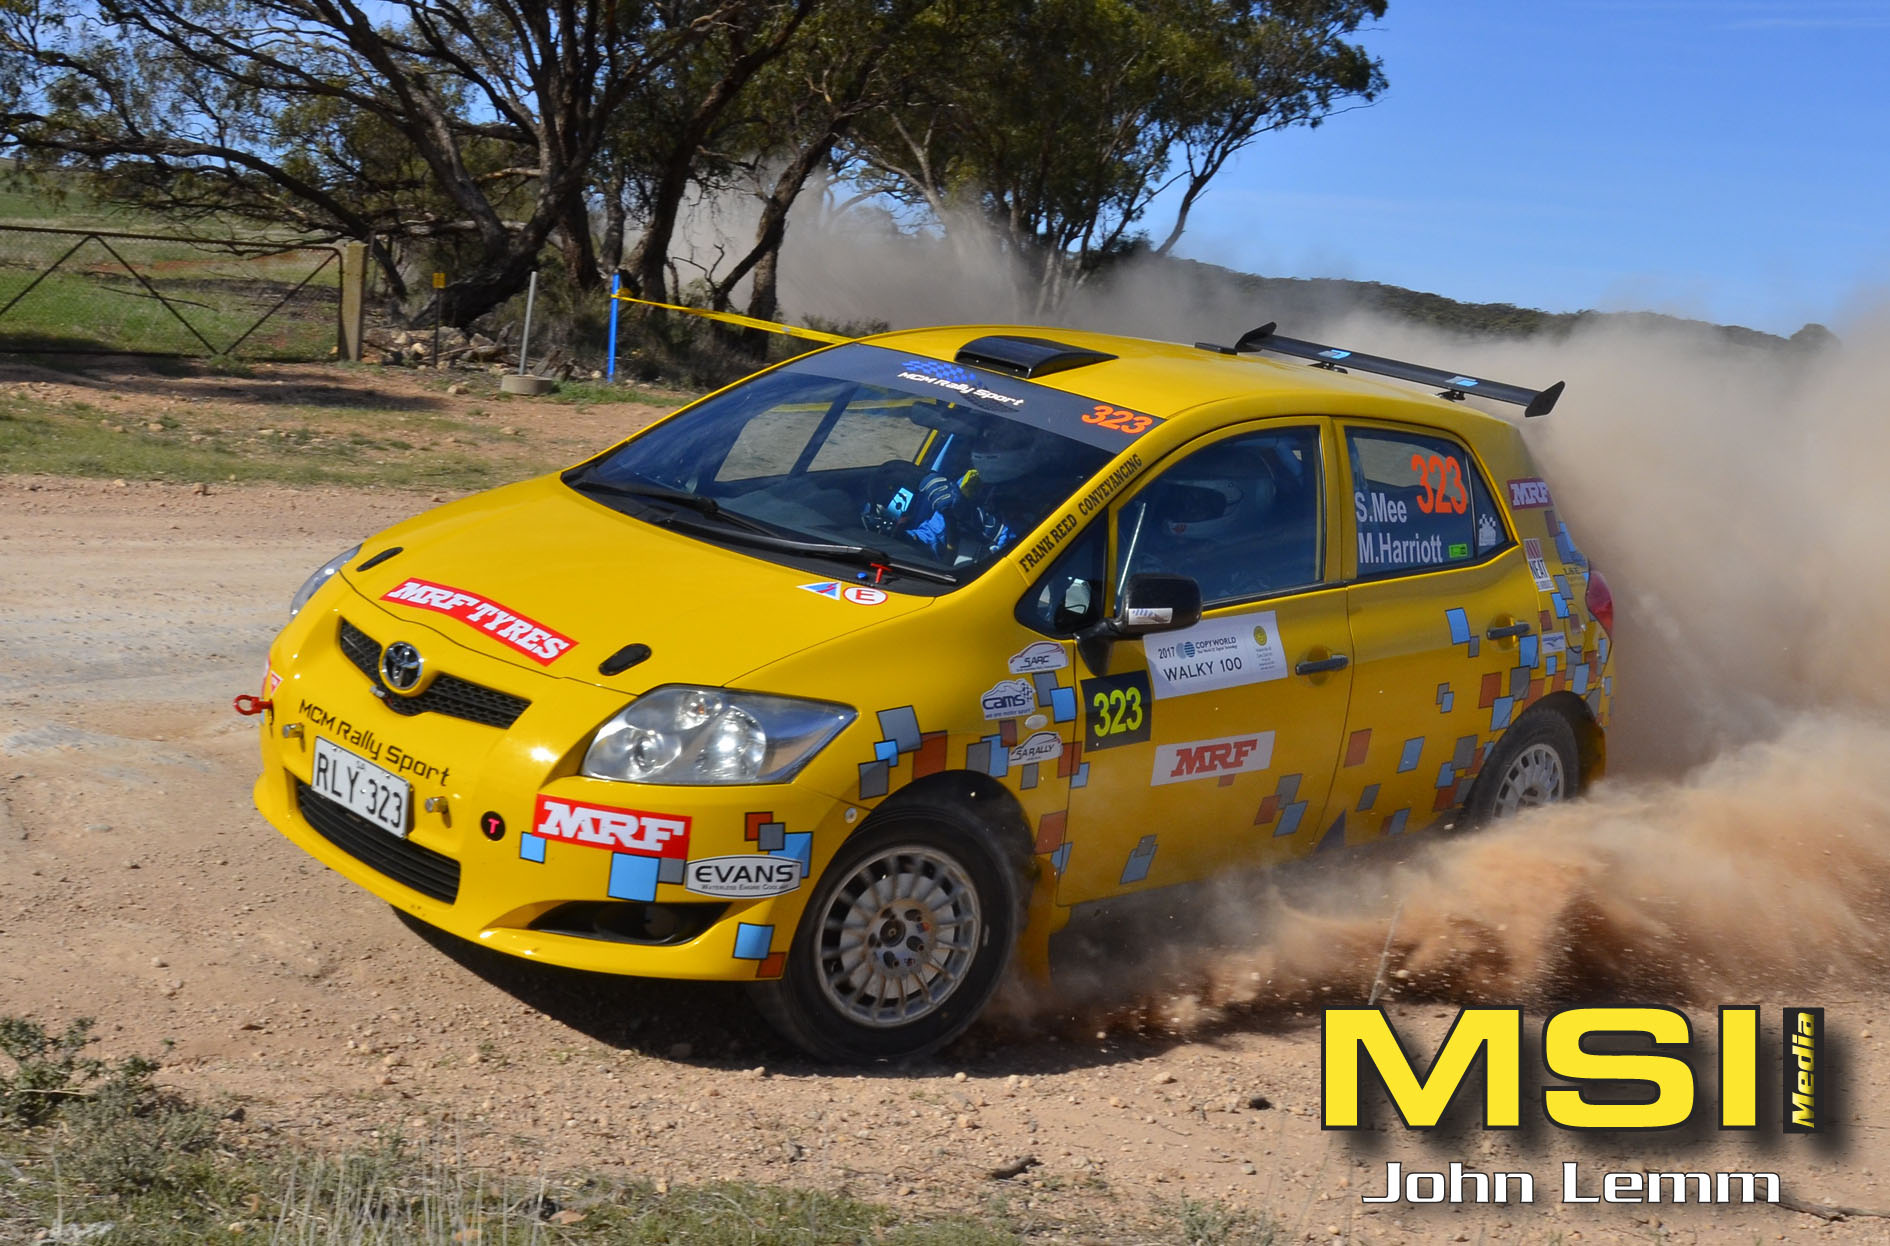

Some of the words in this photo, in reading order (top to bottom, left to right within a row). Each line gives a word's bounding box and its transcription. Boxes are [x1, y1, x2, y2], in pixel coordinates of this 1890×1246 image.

[897, 371, 936, 384] MCM
[934, 379, 975, 394] Rally
[974, 389, 1024, 406] Sport
[1081, 405, 1153, 434] 323
[1411, 454, 1468, 514] 323
[1511, 482, 1548, 506] MRF
[1019, 535, 1055, 572] FRANK
[1050, 514, 1077, 543] REED
[1078, 453, 1142, 516] CONVEYANCING
[1354, 491, 1408, 523] S.Mee
[1358, 532, 1443, 564] M.Harriott
[387, 582, 480, 610] MRF
[466, 603, 570, 659] TYRES
[1158, 646, 1175, 659] 2017
[1163, 661, 1214, 681] WALKY
[1220, 657, 1243, 673] 100
[1093, 686, 1143, 737] 323
[299, 699, 336, 731] MCM
[336, 720, 383, 760] Rally
[385, 745, 450, 787] Sport
[1170, 739, 1257, 777] MRF
[316, 752, 359, 804] RLY
[366, 779, 403, 828] 323
[487, 818, 500, 833] T
[538, 801, 685, 851] MRF
[695, 865, 793, 883] EVANS
